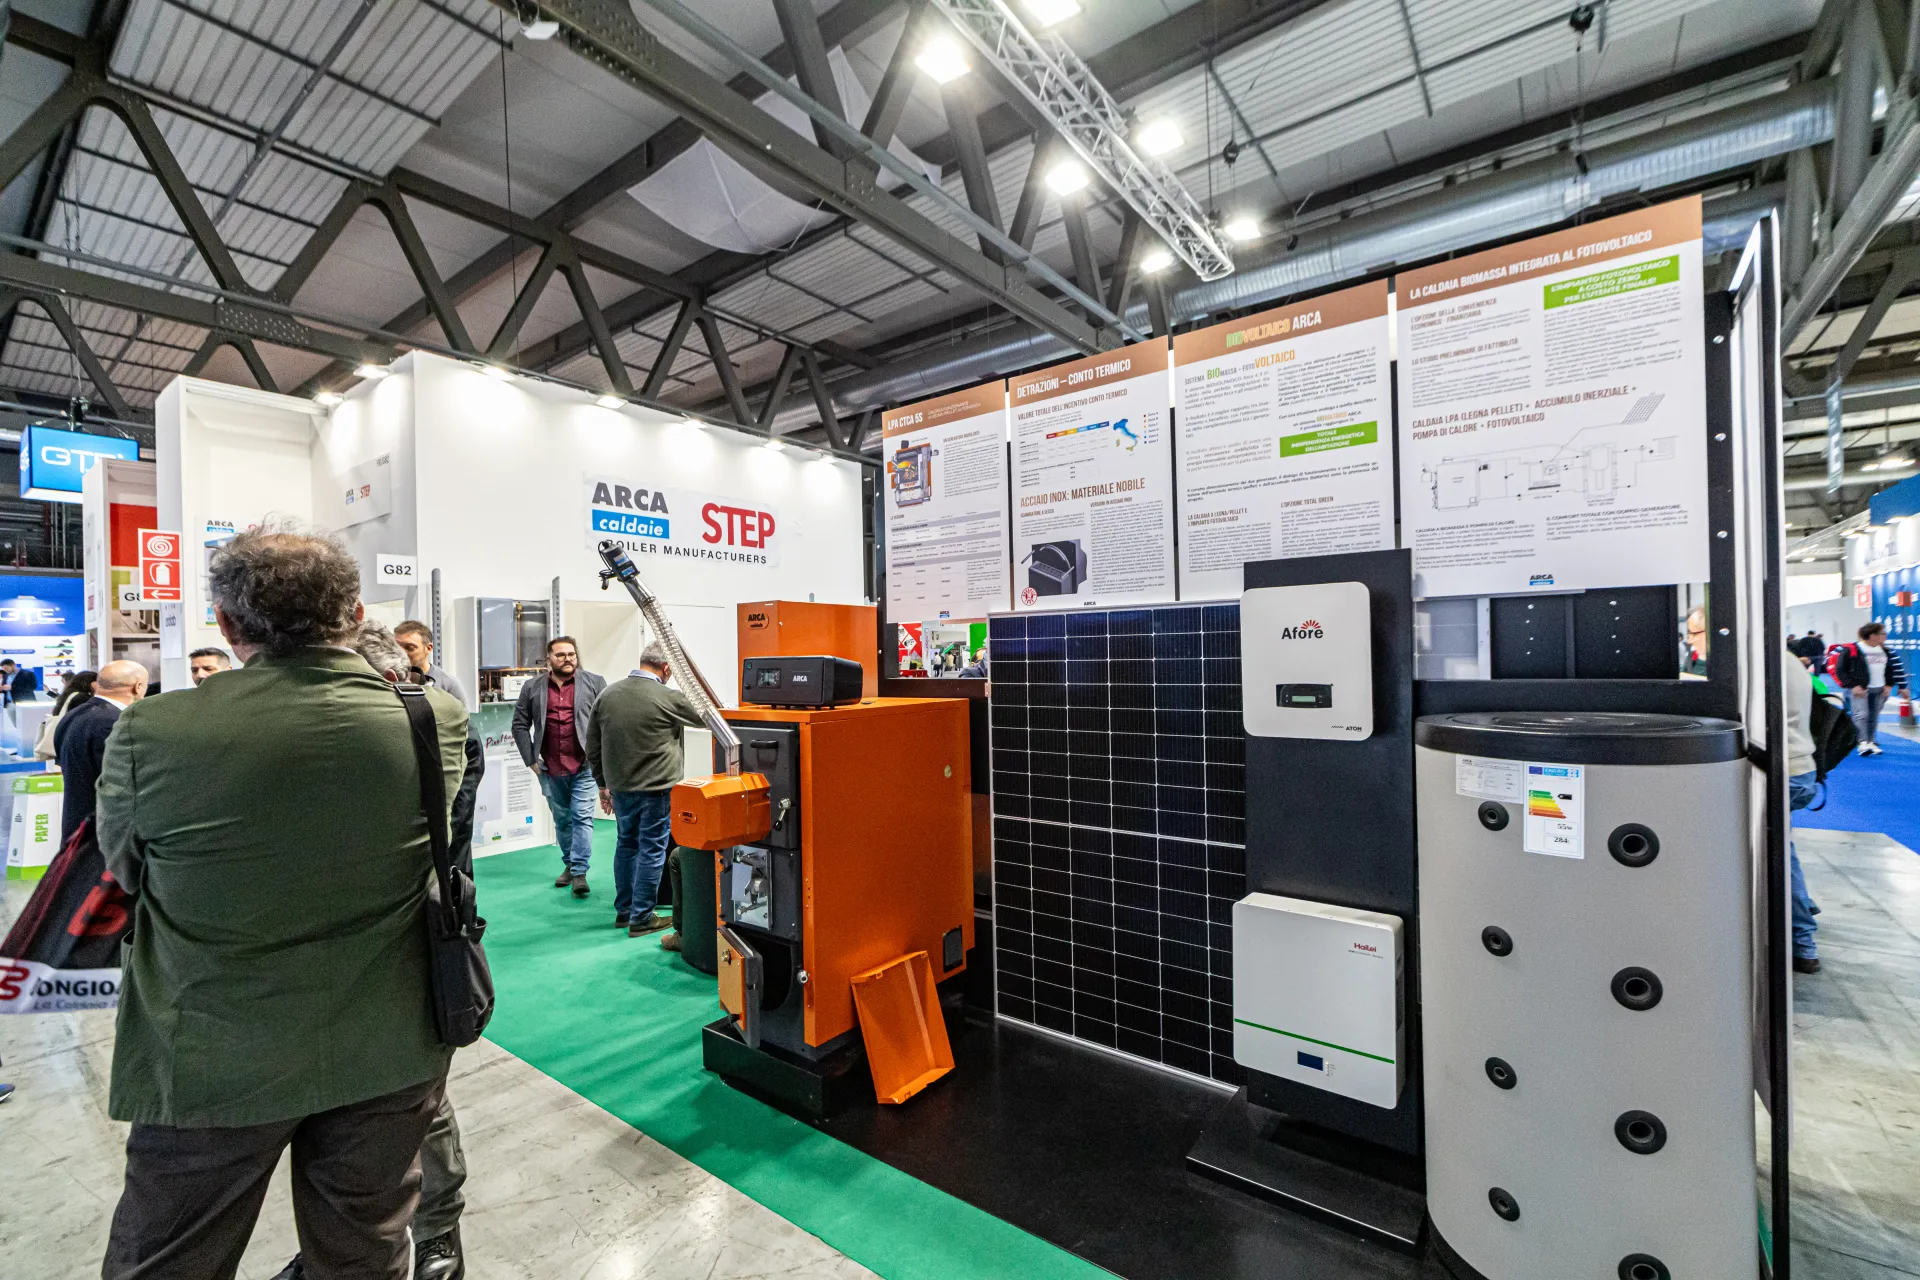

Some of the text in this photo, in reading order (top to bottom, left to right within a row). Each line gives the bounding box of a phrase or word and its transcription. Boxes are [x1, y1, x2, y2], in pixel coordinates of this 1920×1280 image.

[1410, 230, 1652, 299] LA CALDAIA BIOMASSA INTEGRATA AL FOTOVOLTAICO
[1551, 260, 1670, 292] L'IMPIANTO FOTOVOLTAICO
[1586, 279, 1615, 291] COSTO
[1618, 274, 1640, 284] ZERO
[1293, 311, 1321, 331] ARCA
[1017, 377, 1059, 398] DETRAZIONI
[1068, 368, 1093, 385] CONTO
[1095, 359, 1131, 379] TERMICO
[1185, 350, 1295, 385] SISTEMA BIOMASSA FOTOVOLTAICO
[1018, 389, 1127, 420] VALORE TOTALE DELL'INCENTIVO CONTO TERMICO
[1413, 416, 1443, 428] CALDAIA
[1446, 414, 1458, 423] LPA
[1461, 409, 1489, 421] (LEGNA
[1491, 403, 1522, 416] PELLET)
[1535, 394, 1581, 409] ACCUMULO
[1583, 386, 1628, 402] INERZIALE
[888, 418, 899, 430] LPA
[900, 414, 913, 427] CTCA
[1413, 413, 1544, 440] POMPA DI CALORE FOTOVOLTAICO
[1331, 432, 1364, 441] ENERGETICA
[592, 482, 669, 514] ARCA
[1020, 478, 1145, 508] ACCIAIO INOX: MATERIALE NOBILE
[600, 517, 664, 536] caldaie
[702, 502, 776, 549] STEP
[664, 546, 767, 564] MANUFACTURERS
[384, 564, 412, 576] G82
[748, 613, 765, 621] ARCA
[1281, 626, 1323, 640] Afore
[35, 814, 48, 842] PAPER
